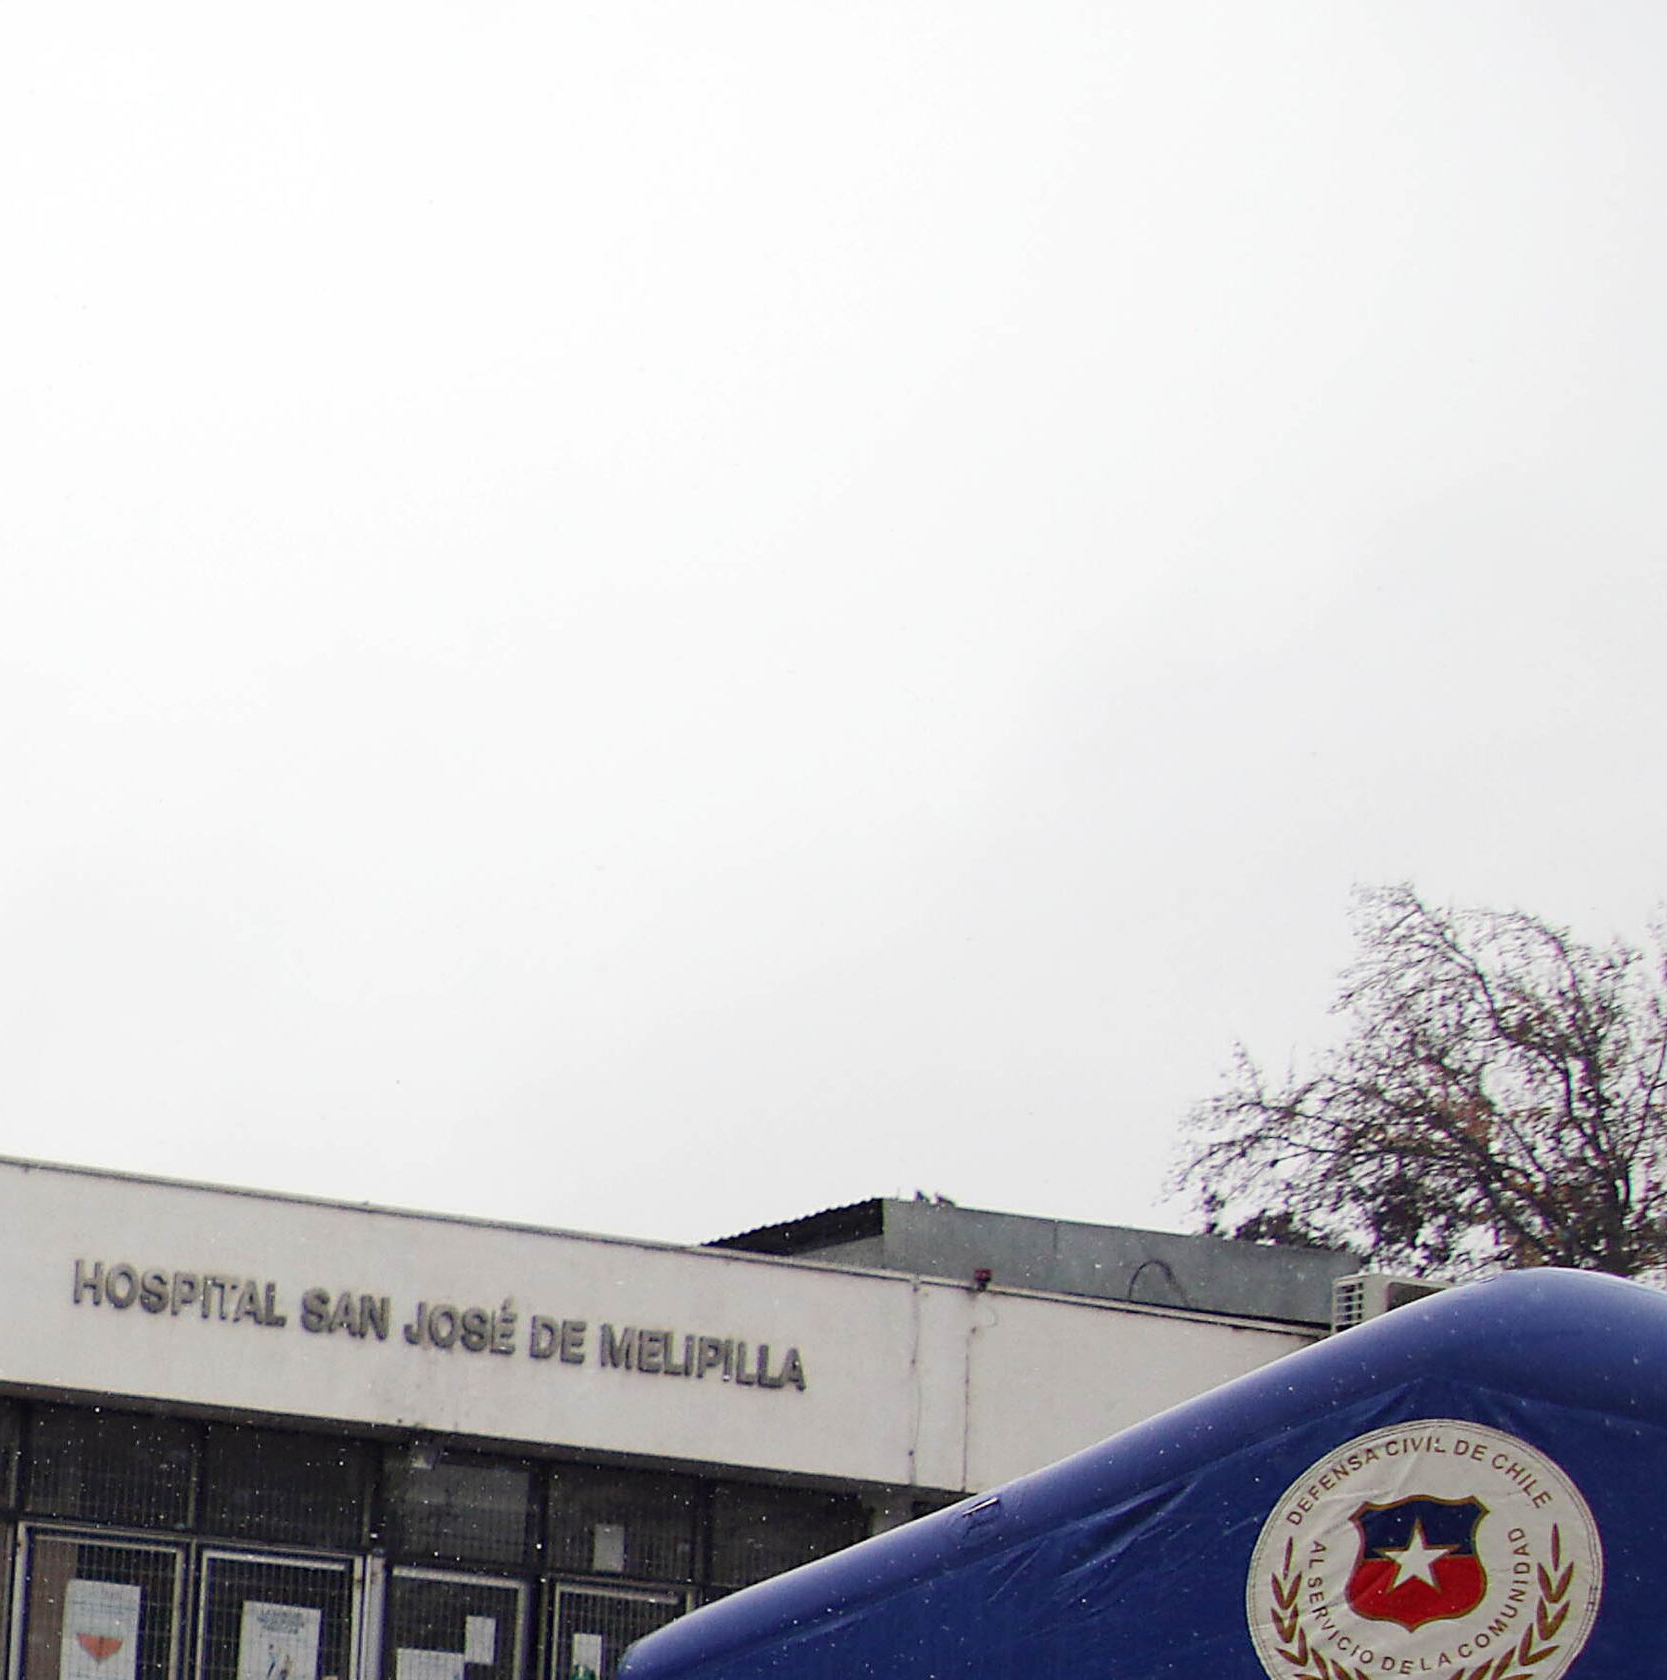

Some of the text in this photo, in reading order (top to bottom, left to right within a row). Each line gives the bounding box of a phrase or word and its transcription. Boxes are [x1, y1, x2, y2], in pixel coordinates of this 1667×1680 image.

[73, 1258, 808, 1393] HOSPITAL SAN JOSÉ DE MELIPILLA
[1286, 1436, 1553, 1526] DEFENSA CIVIL DE CHILE
[1308, 1540, 1327, 1568] AL
[1457, 1527, 1532, 1658] COMUNIDAD
[1307, 1576, 1374, 1664] SERVICIO
